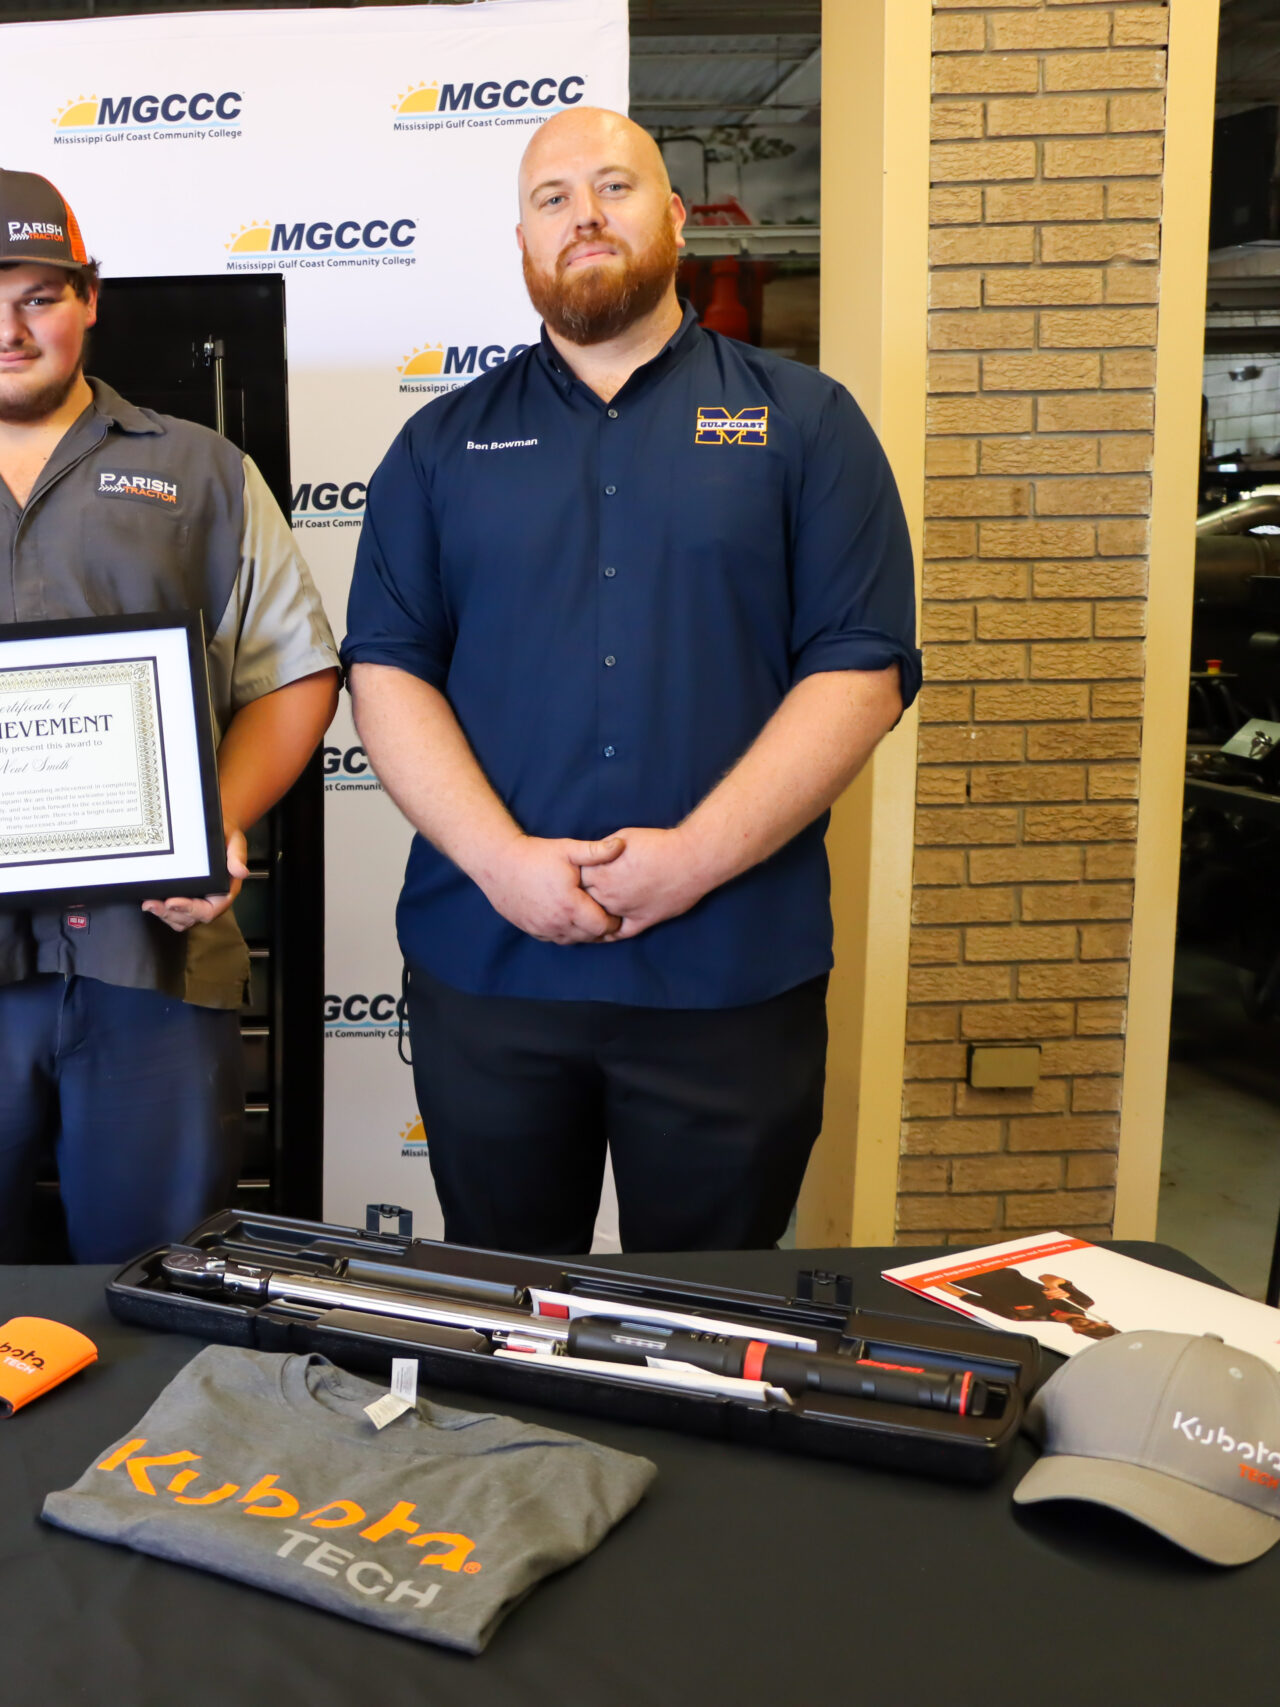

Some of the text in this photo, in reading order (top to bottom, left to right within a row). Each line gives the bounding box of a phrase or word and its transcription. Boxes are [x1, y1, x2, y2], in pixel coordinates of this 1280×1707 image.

[438, 76, 585, 111] MGCCC
[97, 91, 242, 125] MGCCC
[393, 121, 444, 132] Mississippi
[446, 119, 465, 129] Gulf
[467, 118, 493, 128] Coast
[54, 128, 242, 145] Mississippi Gulf Coast Community College
[8, 221, 63, 236] PARISH
[270, 218, 416, 251] MGCCC
[28, 233, 64, 242] TRACTOR
[227, 256, 417, 272] Mississippi Gulf Coast Community College
[399, 383, 449, 393] Mississippi
[729, 421, 764, 429] COAST
[466, 438, 538, 450] Ben Bowman
[100, 473, 177, 496] PARISH
[123, 485, 177, 504] TRACTOR
[305, 519, 330, 528] Coast
[11, 743, 45, 754] present
[47, 741, 63, 751] this
[65, 740, 92, 749] award
[93, 739, 103, 747] to
[335, 1028, 386, 1039] Community
[3, 1356, 36, 1375] TECH
[1237, 1463, 1280, 1490] TECH
[96, 1438, 478, 1574] Kubota
[274, 1528, 445, 1609] TECH
